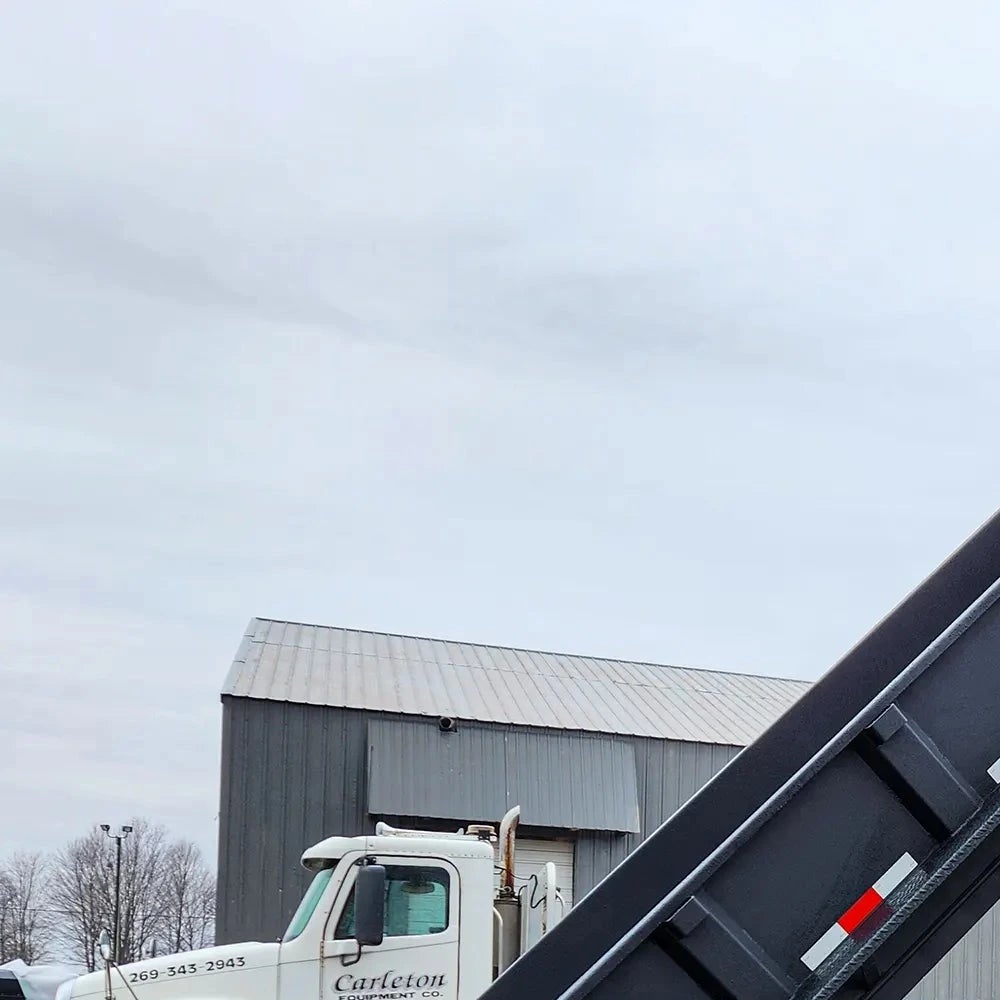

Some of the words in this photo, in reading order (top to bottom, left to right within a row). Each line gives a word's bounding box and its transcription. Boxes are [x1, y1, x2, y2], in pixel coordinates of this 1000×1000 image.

[129, 956, 246, 983] 269-343-2943
[333, 969, 447, 993] Carleton
[421, 990, 444, 998] CO.
